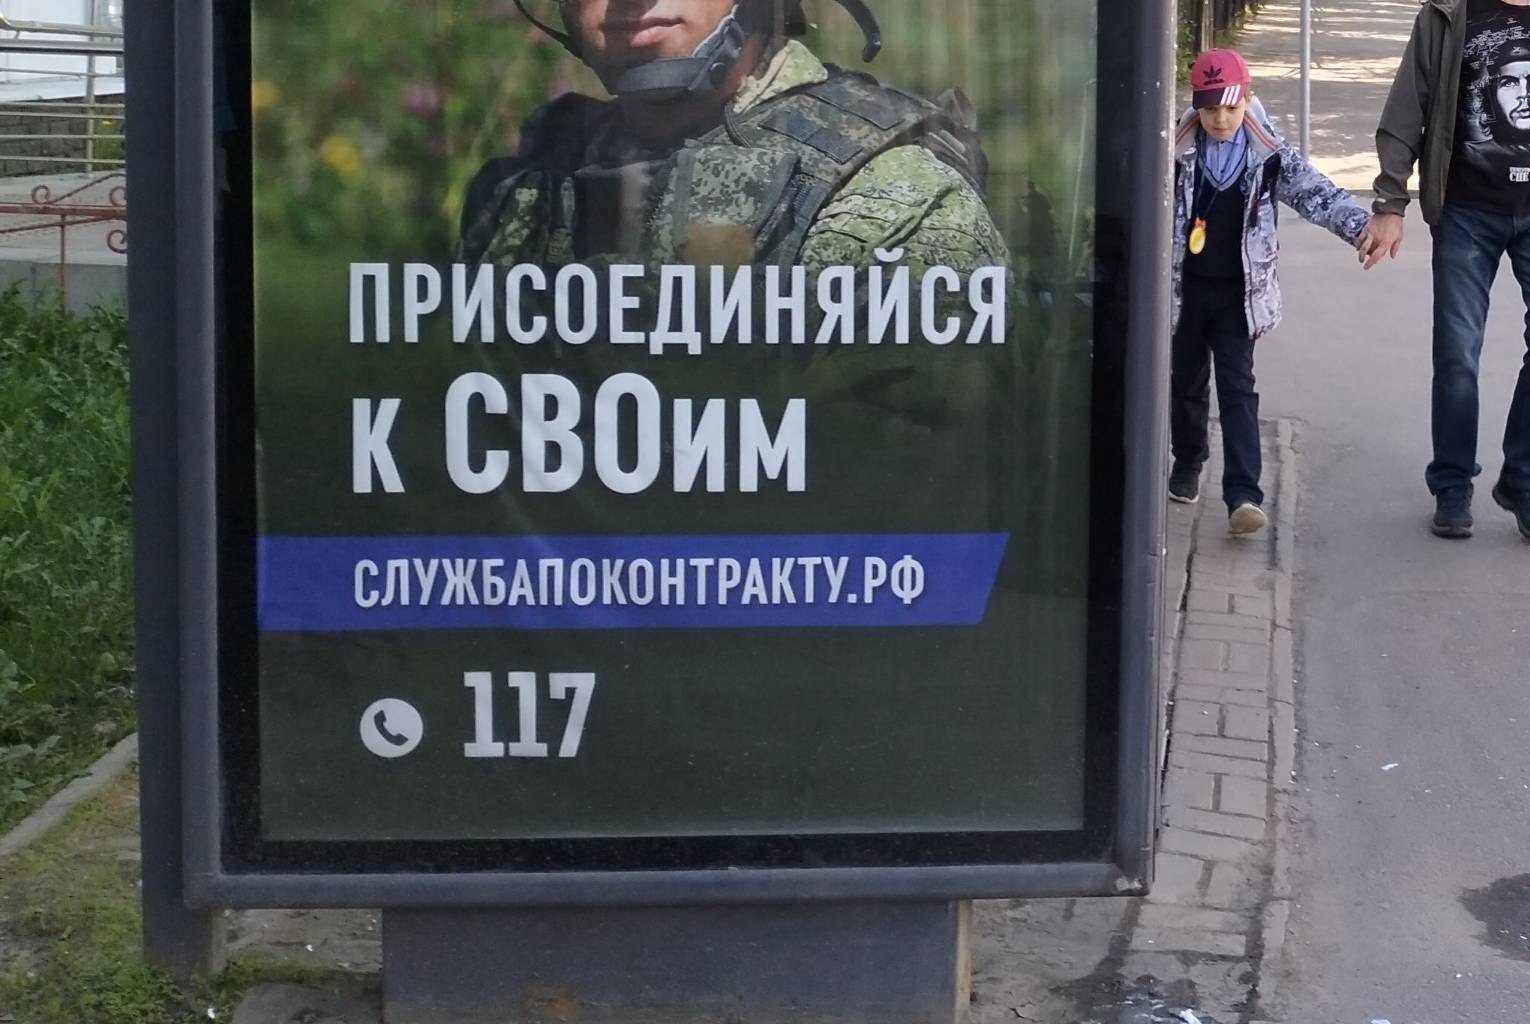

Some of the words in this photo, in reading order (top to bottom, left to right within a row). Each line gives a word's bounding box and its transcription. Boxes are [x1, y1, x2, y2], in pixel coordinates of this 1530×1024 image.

[350, 247, 1006, 355] ПРИСОЕДИНЯЙСЯ
[354, 554, 924, 608] СЛУЖБАПОКОНТРАКТУ.РФ
[463, 671, 596, 758] 117
